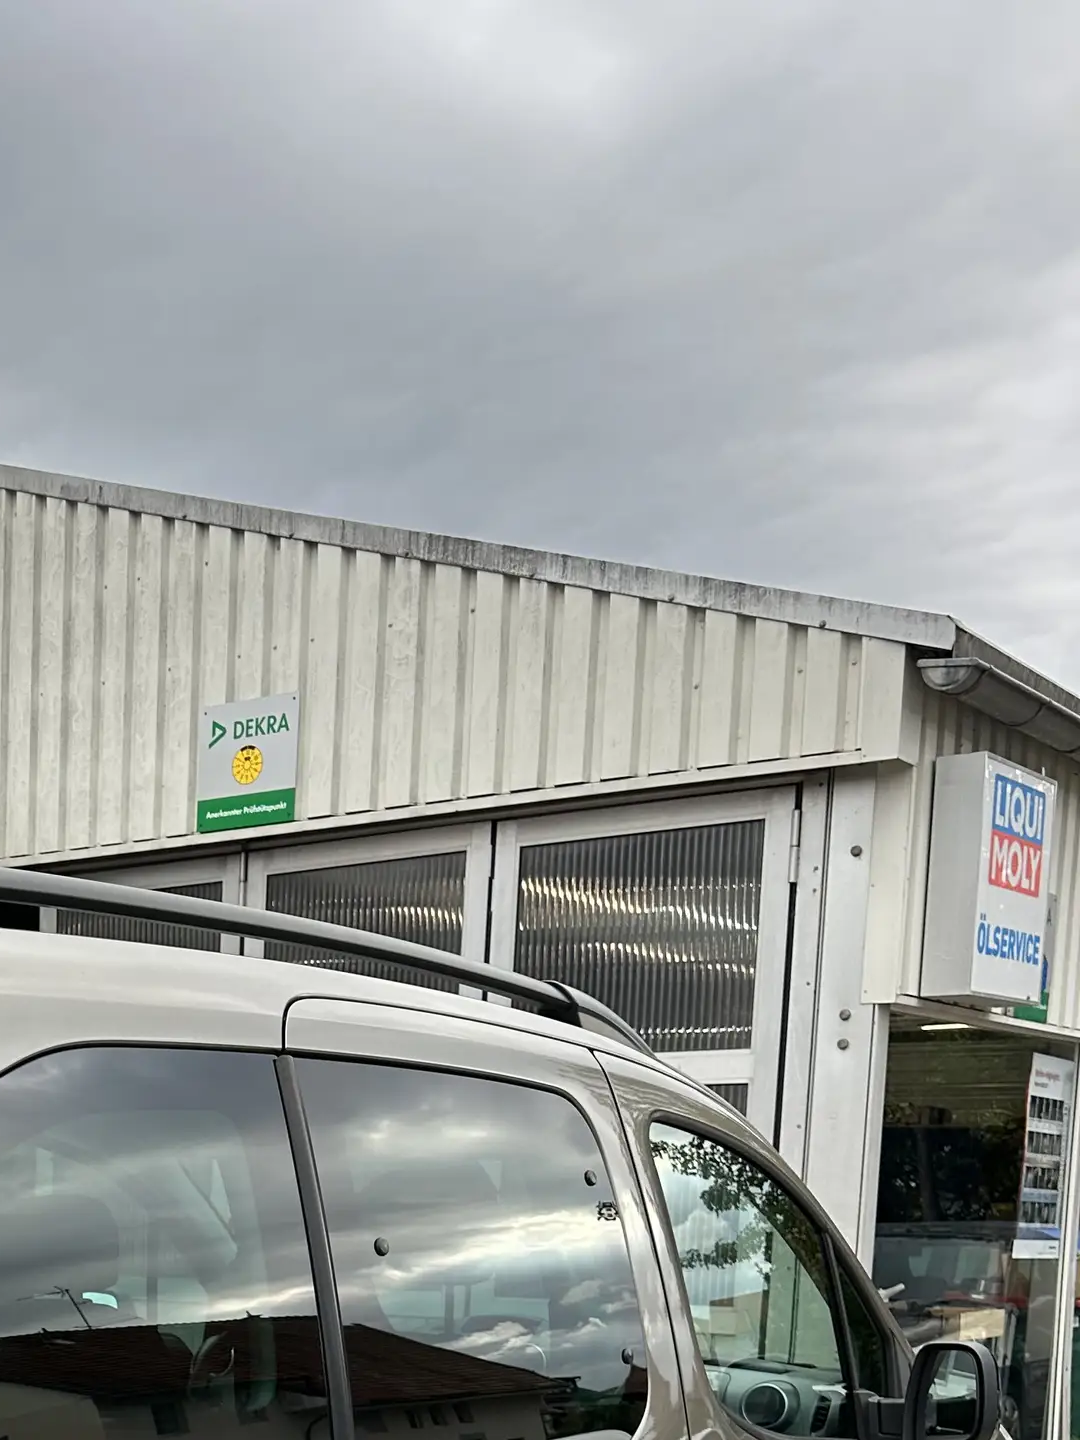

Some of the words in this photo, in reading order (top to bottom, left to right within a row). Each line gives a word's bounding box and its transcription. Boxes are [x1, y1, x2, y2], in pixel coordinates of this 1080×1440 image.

[233, 713, 290, 739] DEKRA
[206, 809, 242, 819] Anerkannter
[995, 780, 1043, 840] LIQUI
[991, 836, 1041, 891] MOLY
[977, 913, 1040, 965] ÖLSERVICE
